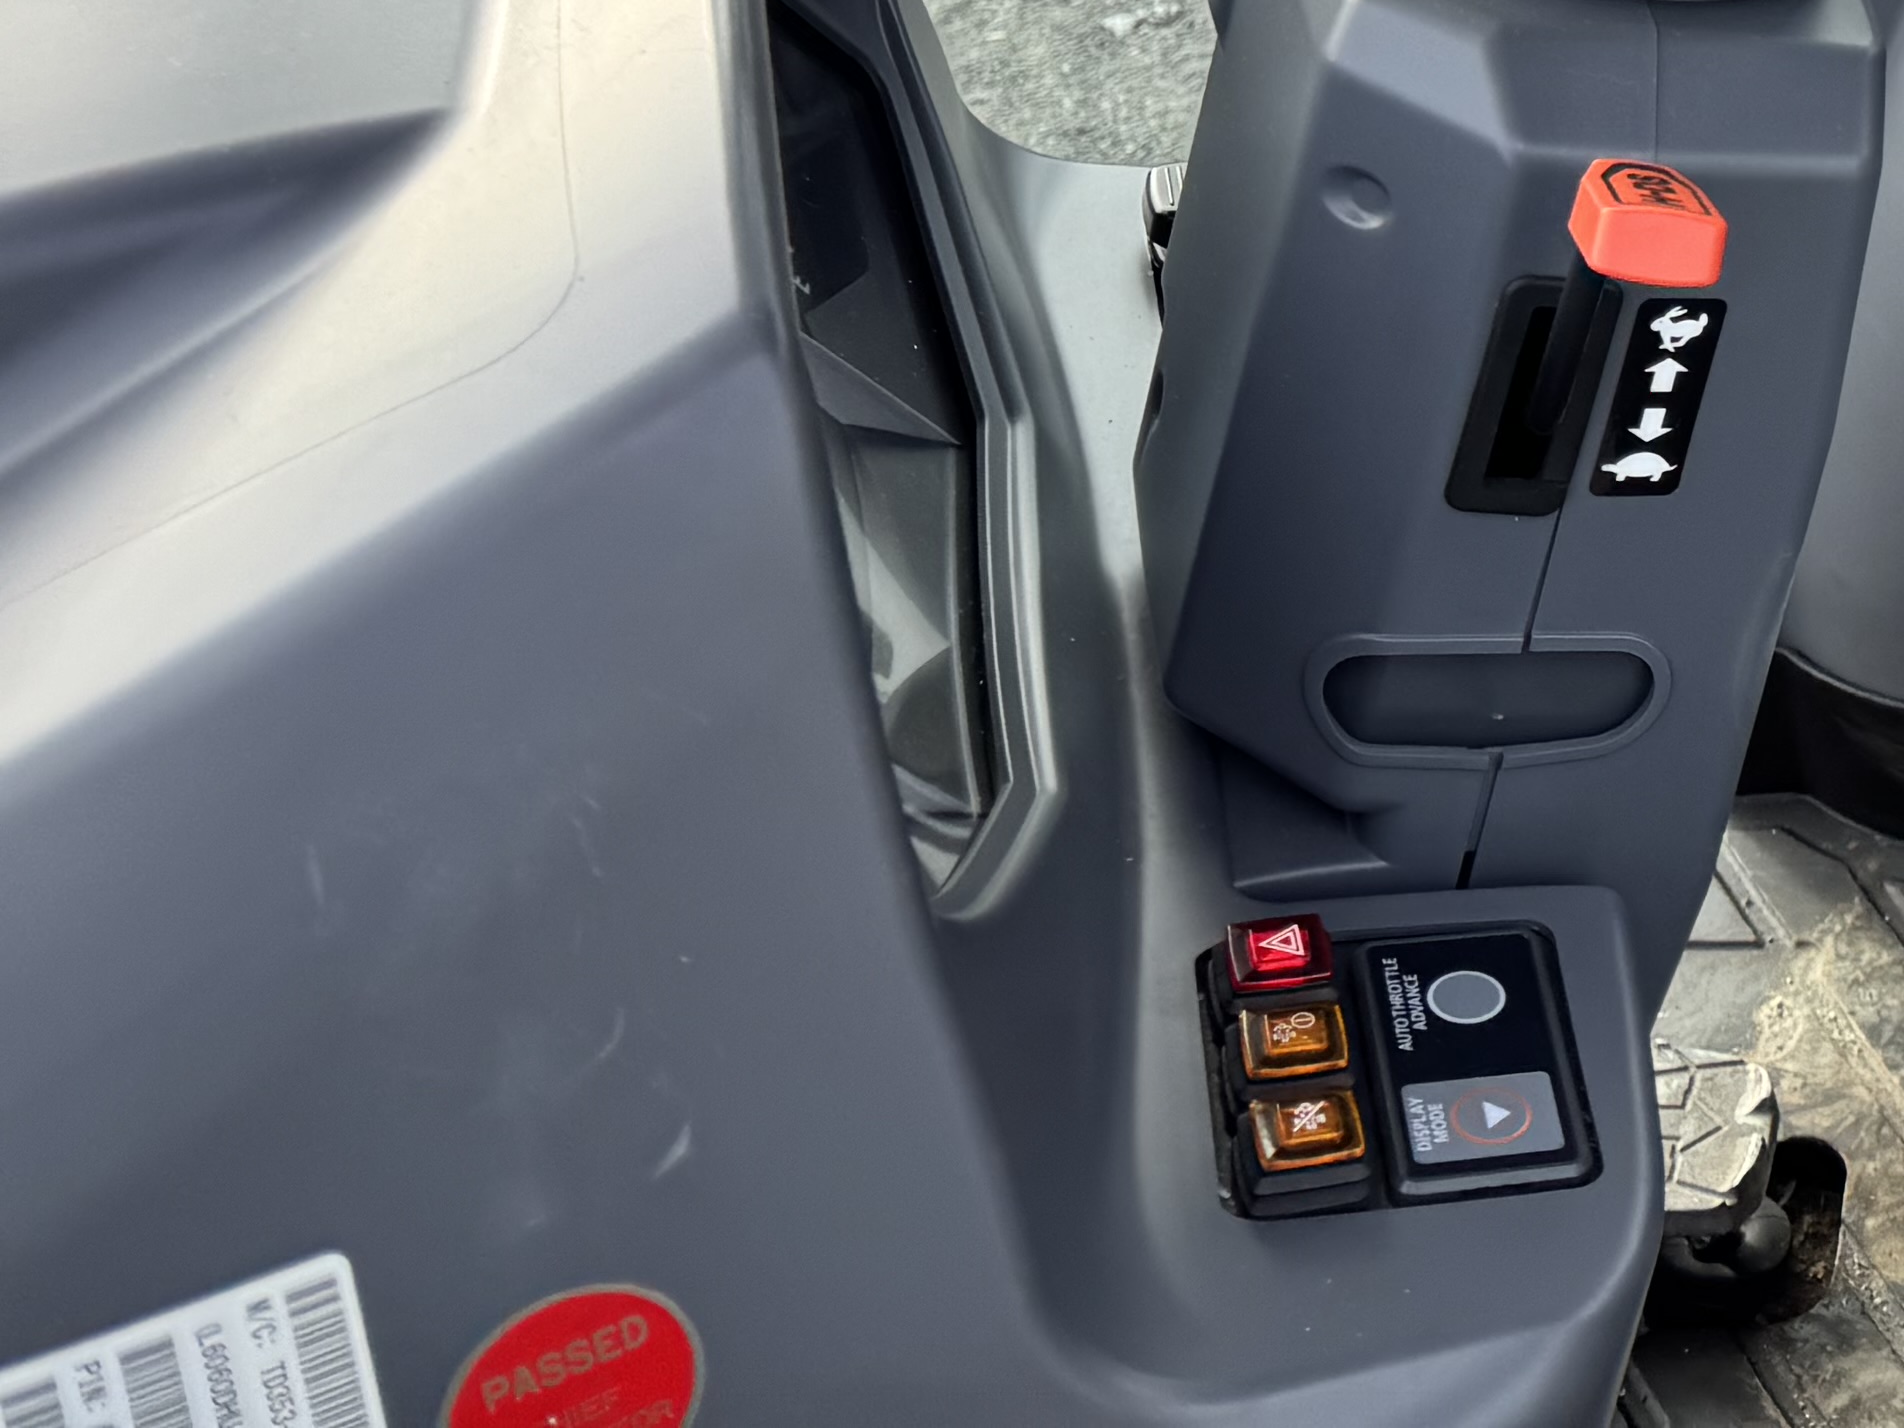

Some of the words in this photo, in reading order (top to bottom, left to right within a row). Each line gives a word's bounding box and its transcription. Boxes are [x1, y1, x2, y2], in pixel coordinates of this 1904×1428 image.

[1402, 974, 1428, 1031] ADVANCE
[1407, 1097, 1432, 1152] DISPLAY
[1428, 1103, 1448, 1144] MODE
[245, 1298, 278, 1350] W/C:
[480, 1314, 649, 1414] PASSED
